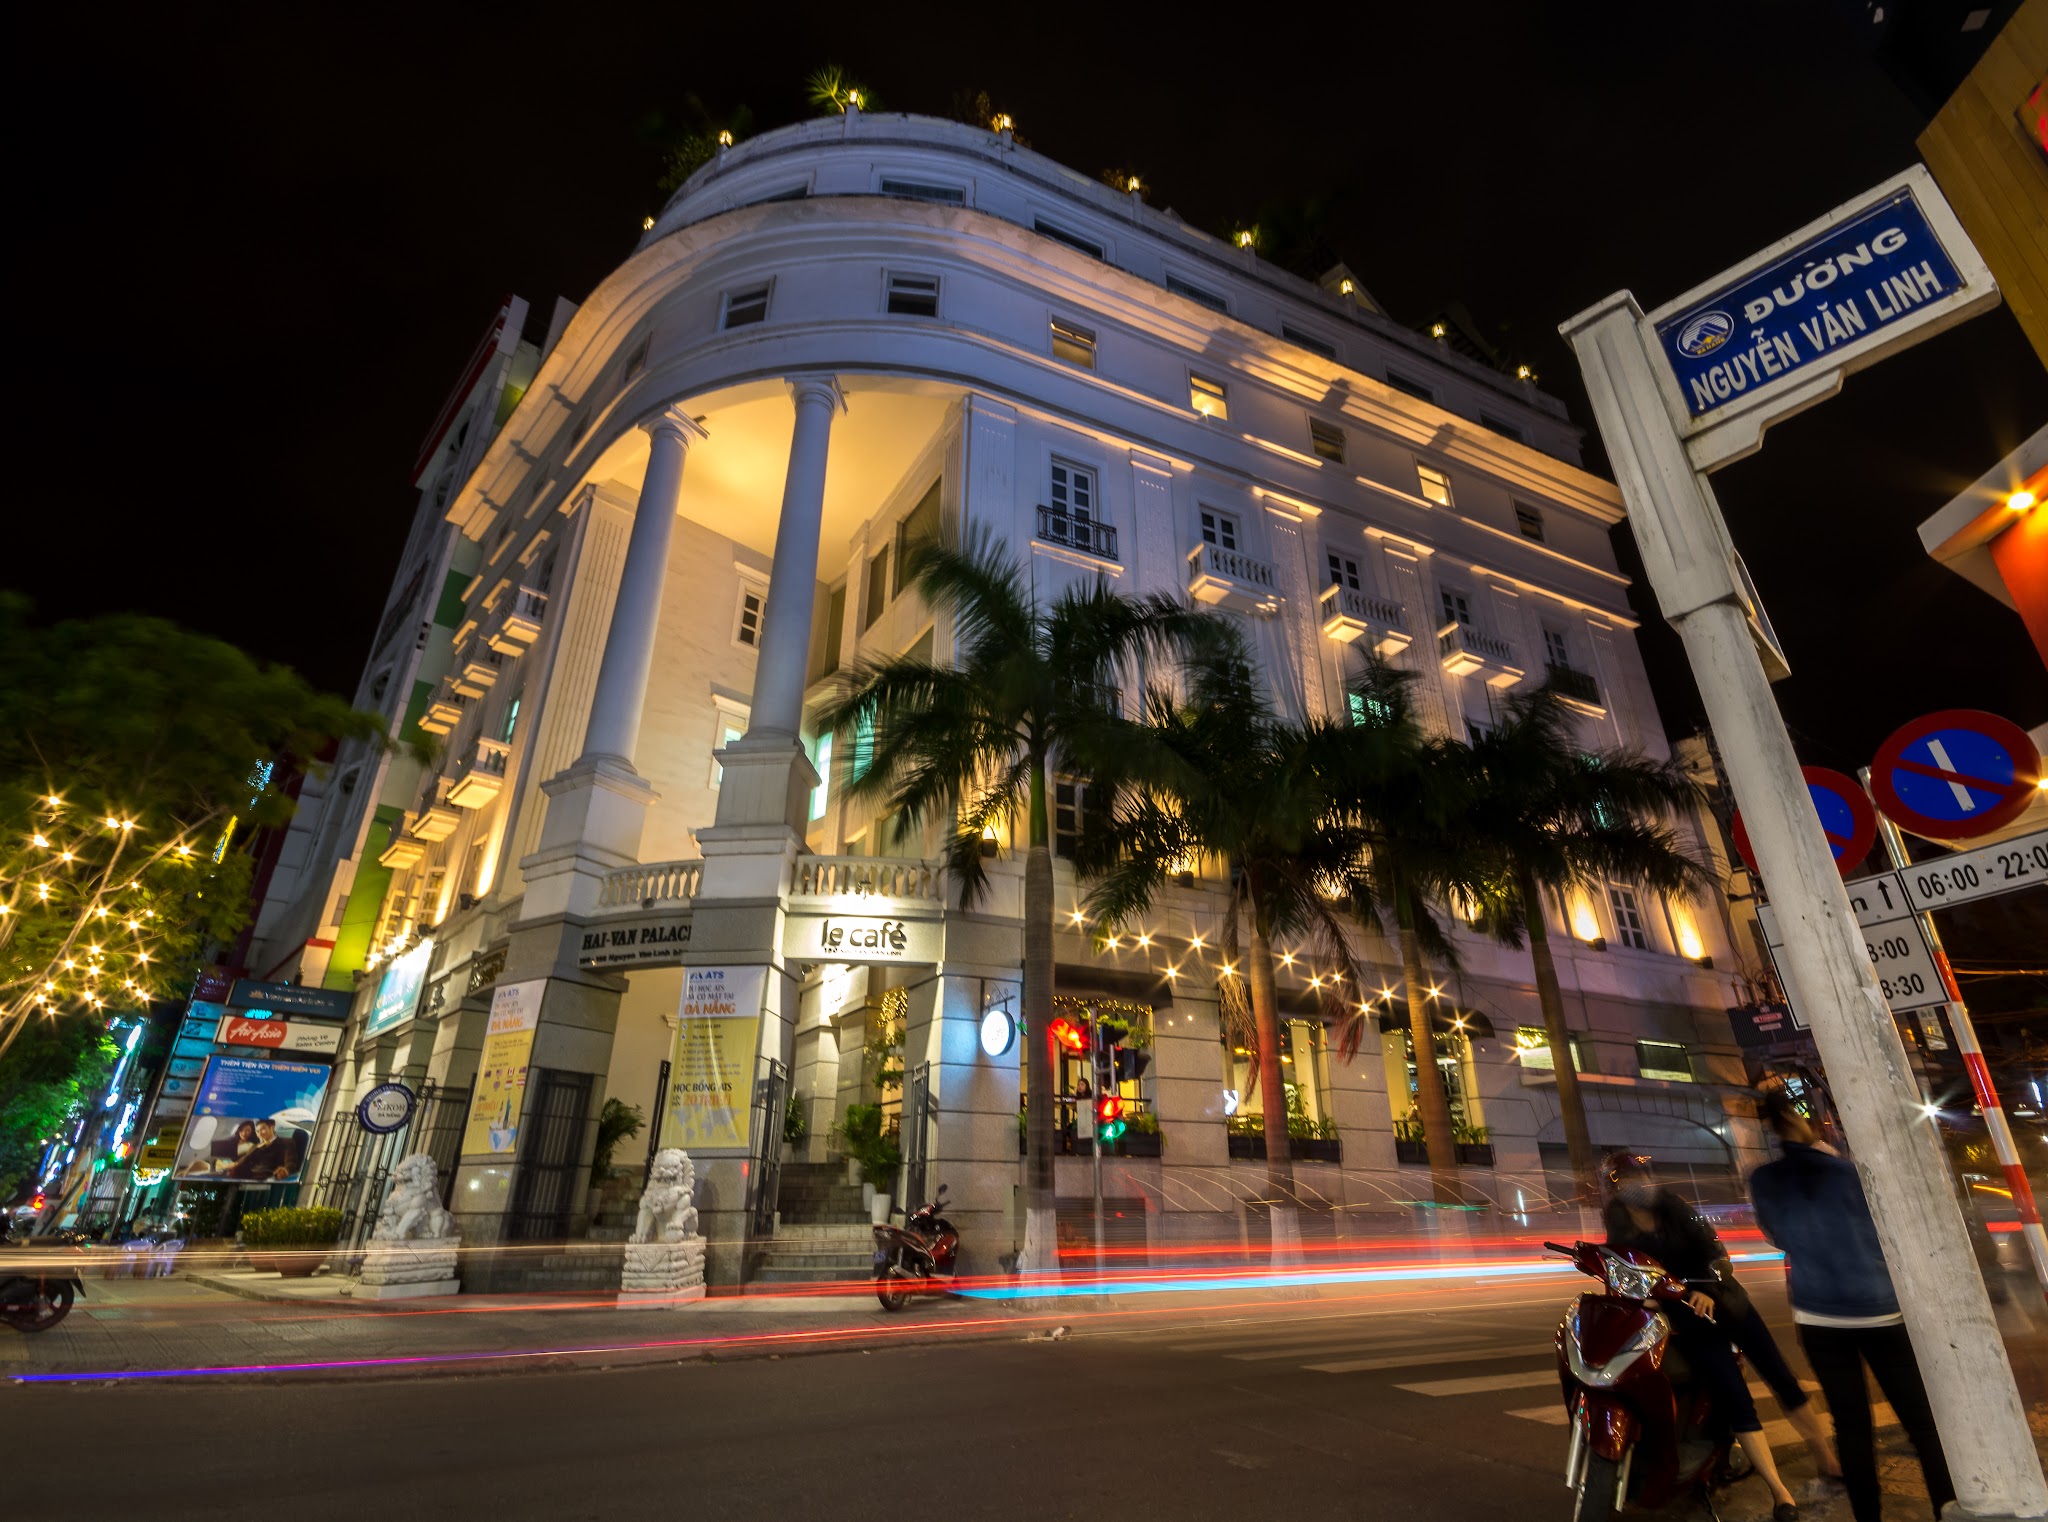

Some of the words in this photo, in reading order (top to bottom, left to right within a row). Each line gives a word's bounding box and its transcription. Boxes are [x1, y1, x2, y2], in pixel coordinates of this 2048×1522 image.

[1744, 226, 1908, 325] ĐƯỜNG
[1690, 328, 1801, 409] NGUYỄN
[1799, 300, 1867, 352] VĂN
[1866, 260, 1943, 322] LINH
[1917, 864, 1980, 899] 06:00
[1997, 842, 2048, 880] 22:0
[582, 928, 638, 950] HAI-VAN
[821, 919, 844, 947] le
[849, 921, 907, 950] café
[1866, 936, 1910, 963] 8:00
[705, 971, 725, 980] ATS
[1879, 973, 1925, 1000] 8:30
